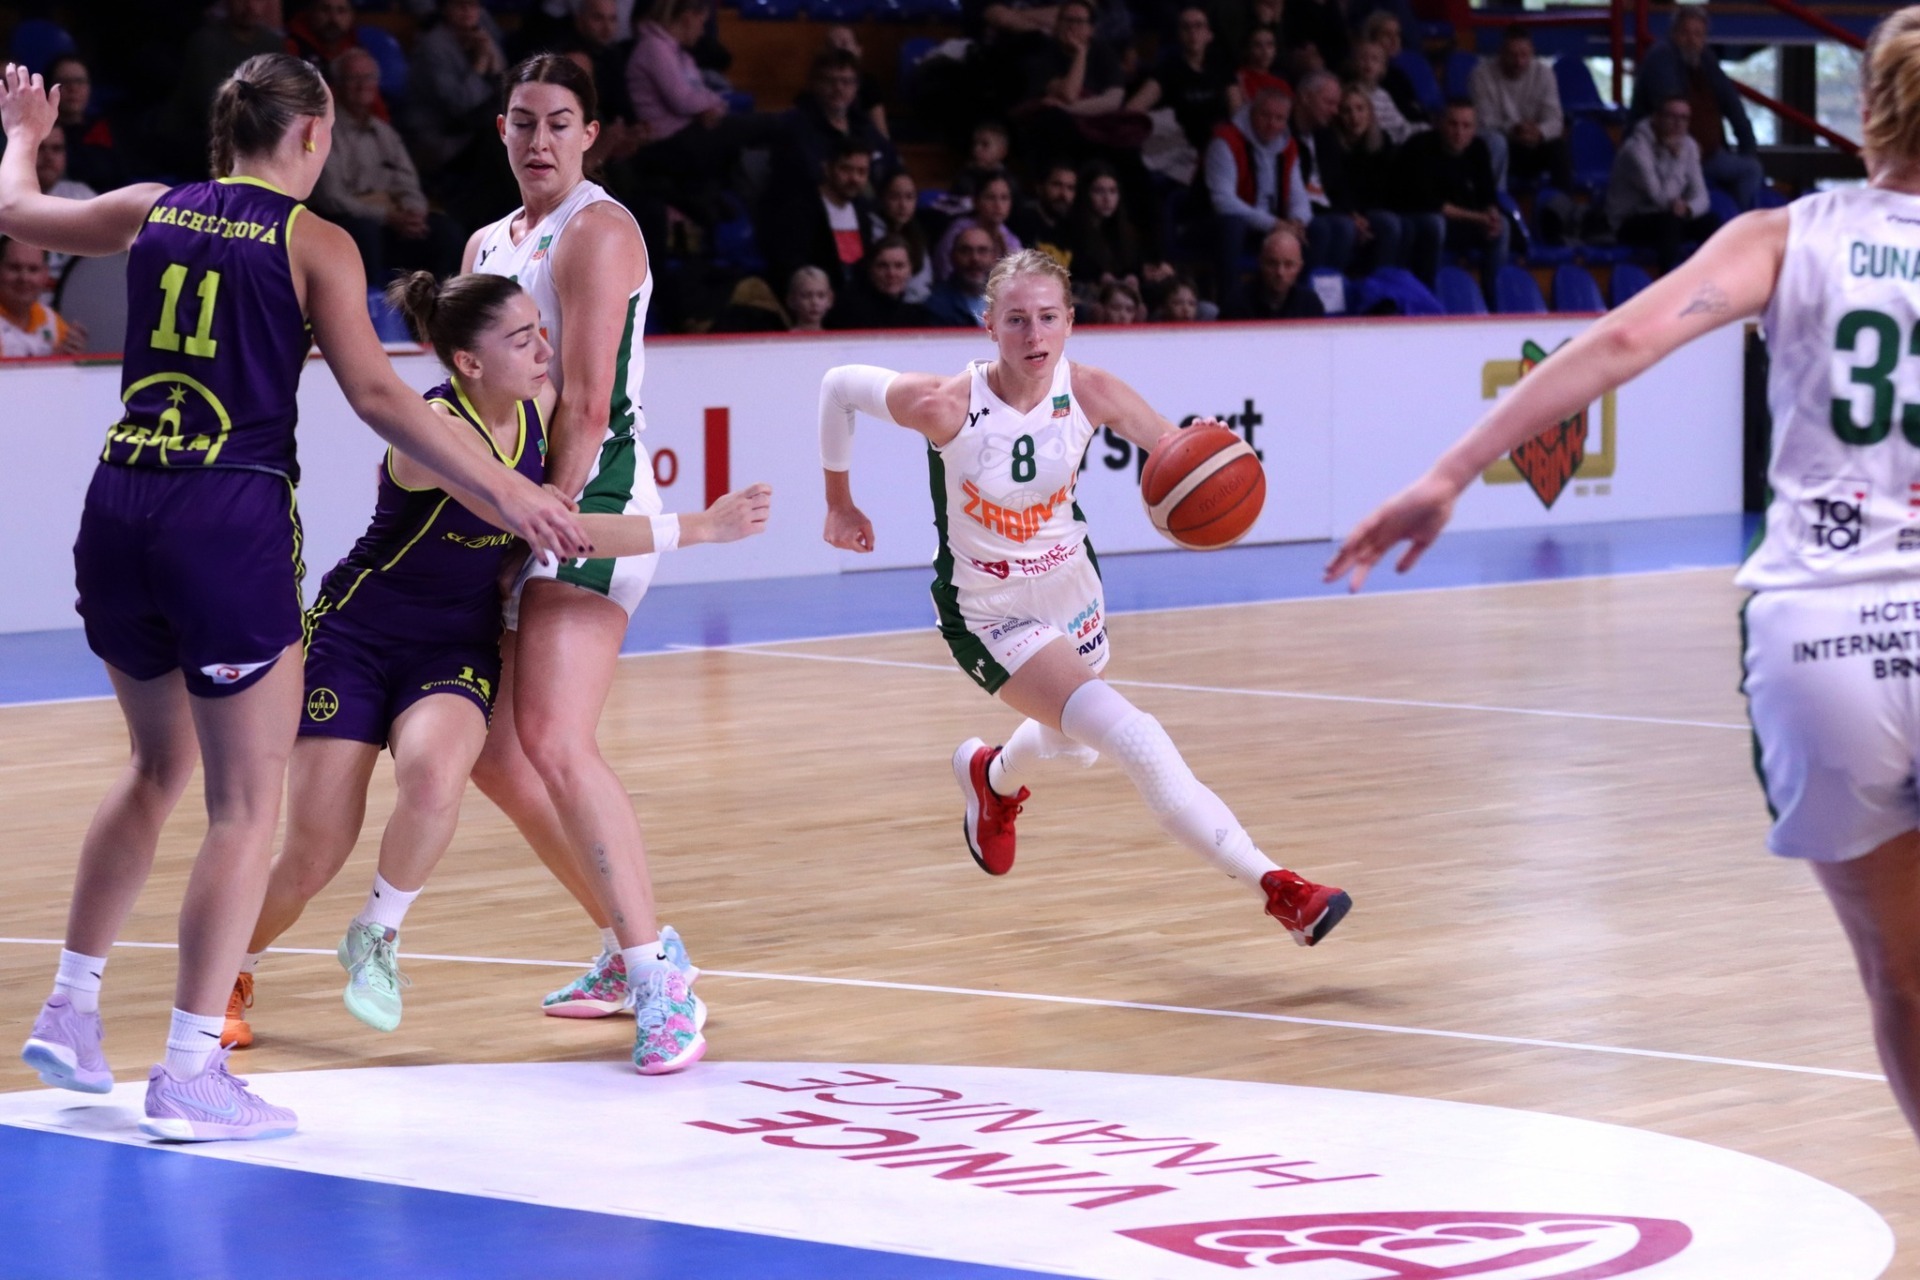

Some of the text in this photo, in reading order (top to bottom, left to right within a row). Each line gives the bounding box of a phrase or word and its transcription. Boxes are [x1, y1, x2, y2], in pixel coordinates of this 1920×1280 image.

[150, 263, 220, 358] 11
[1830, 310, 1920, 448] 3
[1012, 434, 1036, 483] 8
[310, 701, 335, 711] TESLA
[684, 1111, 1179, 1211] VINICE
[740, 1070, 1384, 1189] HNANICE
